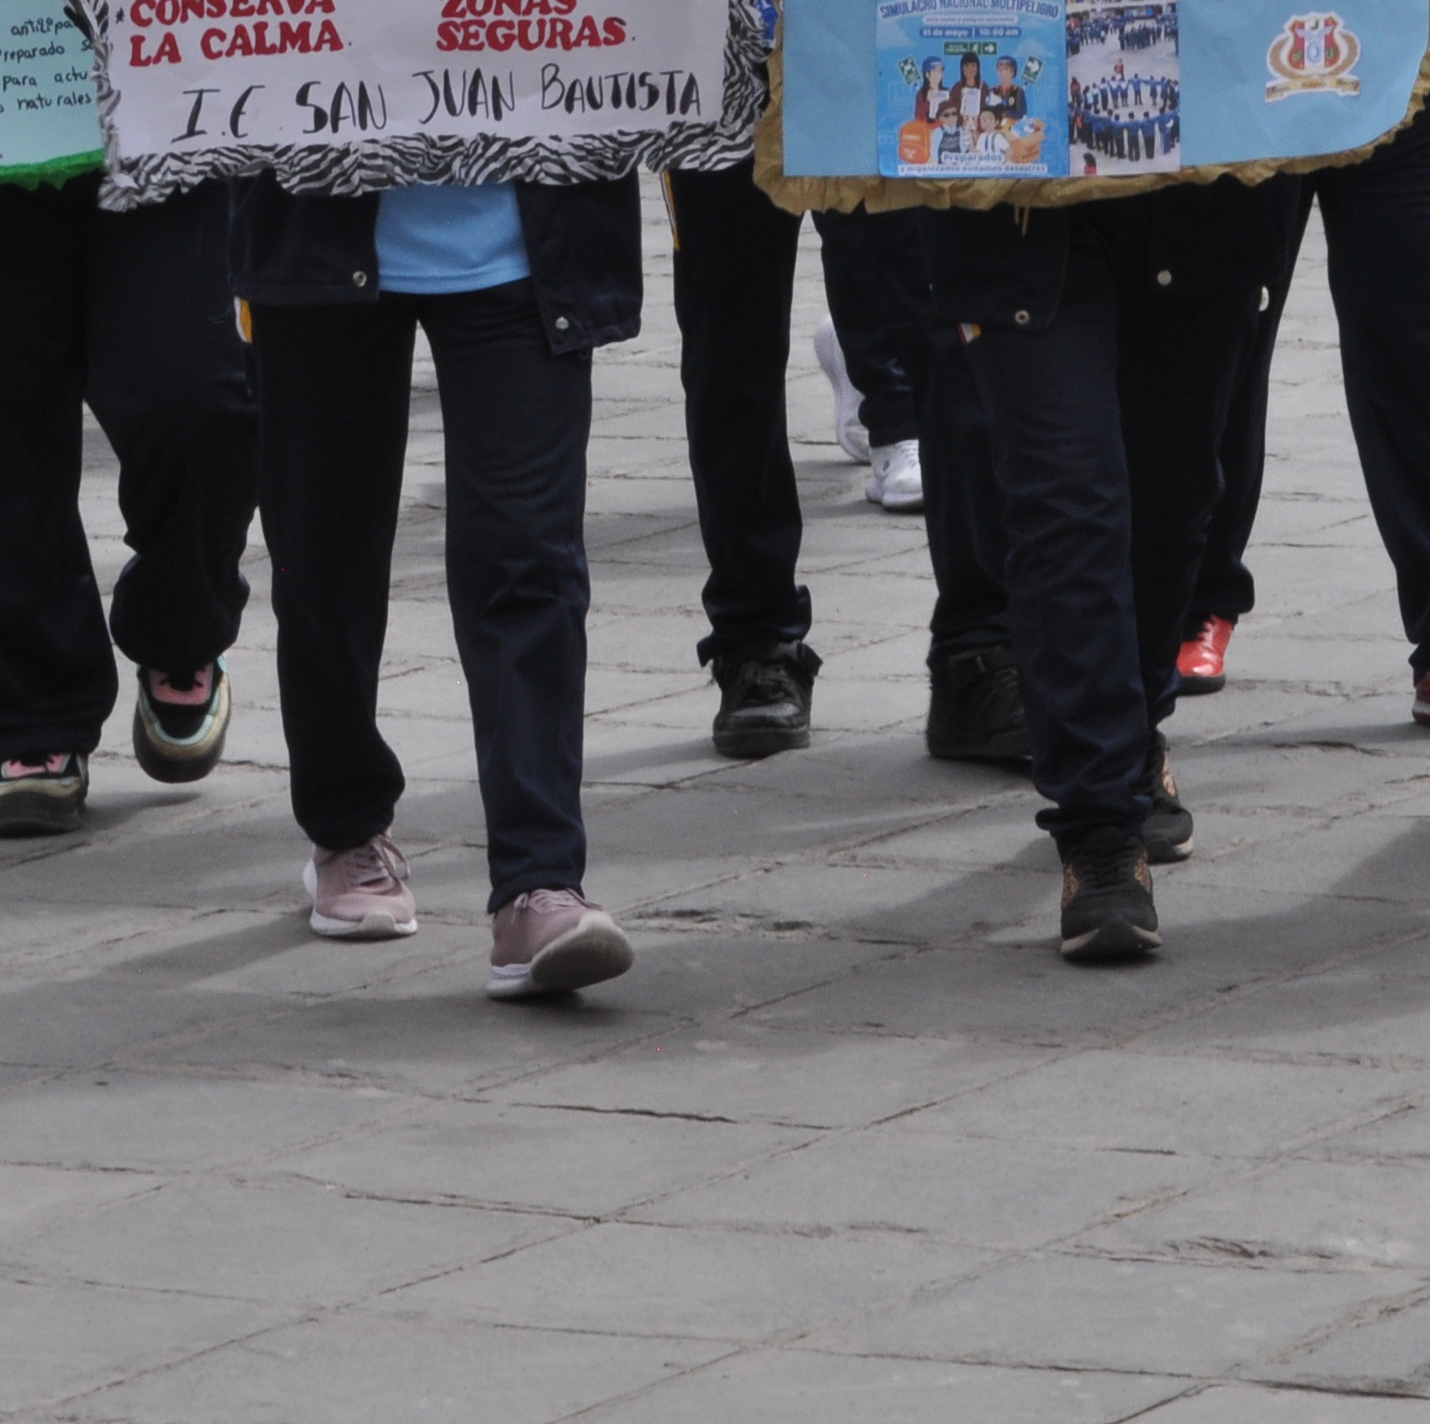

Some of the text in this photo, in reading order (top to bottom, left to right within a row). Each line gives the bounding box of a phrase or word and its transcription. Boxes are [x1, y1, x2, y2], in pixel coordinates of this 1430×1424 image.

[129, 32, 182, 67] LA
[2, 75, 38, 93] para
[17, 92, 92, 111] naturales
[295, 80, 387, 134] SAN
[411, 67, 515, 125] JUAN
[541, 63, 701, 117] BAUTISTA
[943, 153, 1003, 165] Preparados
